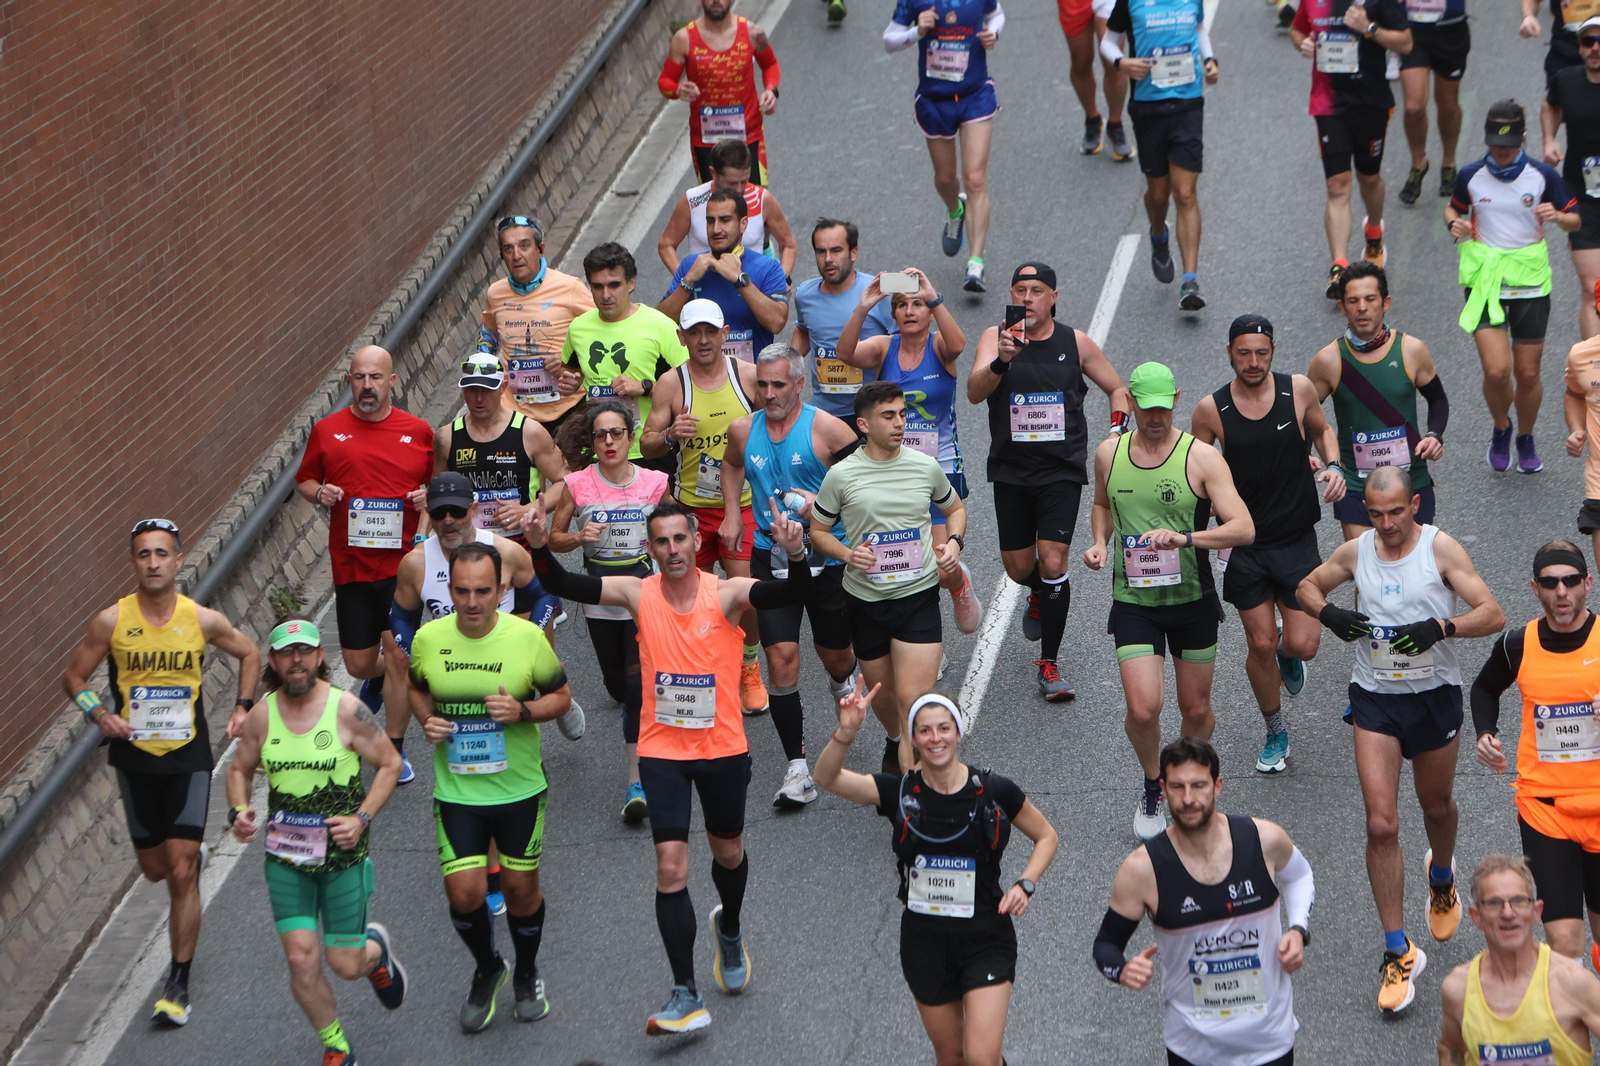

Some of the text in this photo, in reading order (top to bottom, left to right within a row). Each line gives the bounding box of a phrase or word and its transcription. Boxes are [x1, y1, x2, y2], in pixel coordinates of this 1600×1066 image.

[941, 42, 966, 50] ZURICH
[714, 107, 740, 115] ZURICH
[523, 360, 544, 368] ZURIC
[1028, 411, 1046, 419] 6805
[1370, 429, 1400, 441] ZURICH
[902, 438, 920, 446] 7975
[1372, 447, 1391, 457] 6904
[469, 470, 518, 488] NoMeCallo
[482, 491, 512, 500] ZURICH
[366, 517, 385, 525] 8413
[611, 512, 642, 520] ZURICH
[883, 532, 913, 542] ZURICH
[884, 549, 903, 559] 7996
[1140, 554, 1159, 563] 6695
[880, 562, 909, 571] CRISTIAN
[127, 651, 192, 671] JAMAICA
[445, 660, 503, 674] DEPORTEMANIA
[676, 677, 710, 685] ZURICH
[675, 694, 696, 703] 9848
[150, 706, 171, 715] 8377
[436, 702, 488, 715] TLETISM
[1555, 704, 1592, 715] ZURICH
[461, 722, 496, 732] ZURICH
[1556, 725, 1579, 735] 9449
[460, 740, 486, 750] 11240
[266, 757, 337, 774] DEPORTEMANIA
[285, 816, 321, 826] ZURICH
[931, 858, 968, 869] ZURICH
[928, 877, 955, 888] 10216
[928, 894, 953, 902] Laetitia
[1213, 958, 1252, 972] ZURICH
[1222, 995, 1256, 1005] Pastrana
[1501, 1044, 1543, 1059] ZURICH
